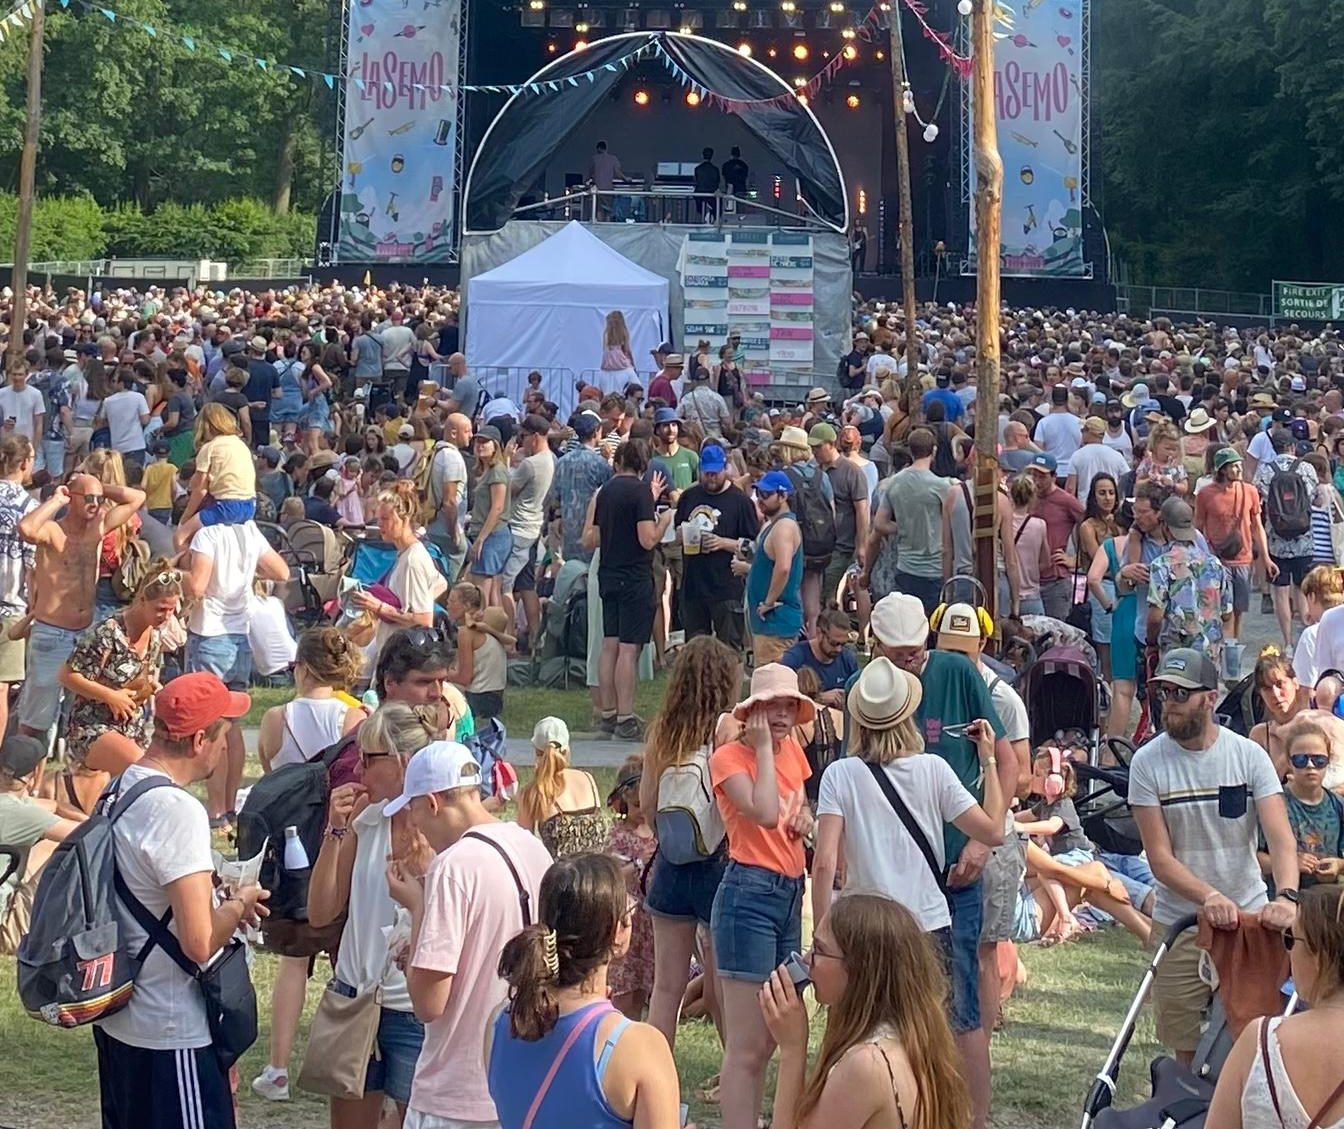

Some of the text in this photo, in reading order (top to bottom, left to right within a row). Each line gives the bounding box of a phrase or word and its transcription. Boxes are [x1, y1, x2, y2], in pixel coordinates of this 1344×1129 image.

[360, 50, 444, 111] LASEMO
[993, 60, 1069, 122] ASEMO
[1281, 298, 1316, 308] SORTIE
[1283, 287, 1303, 297] FIRE
[1305, 287, 1327, 297] EXIT
[1283, 309, 1327, 319] SECOURS
[76, 952, 114, 991] 77
